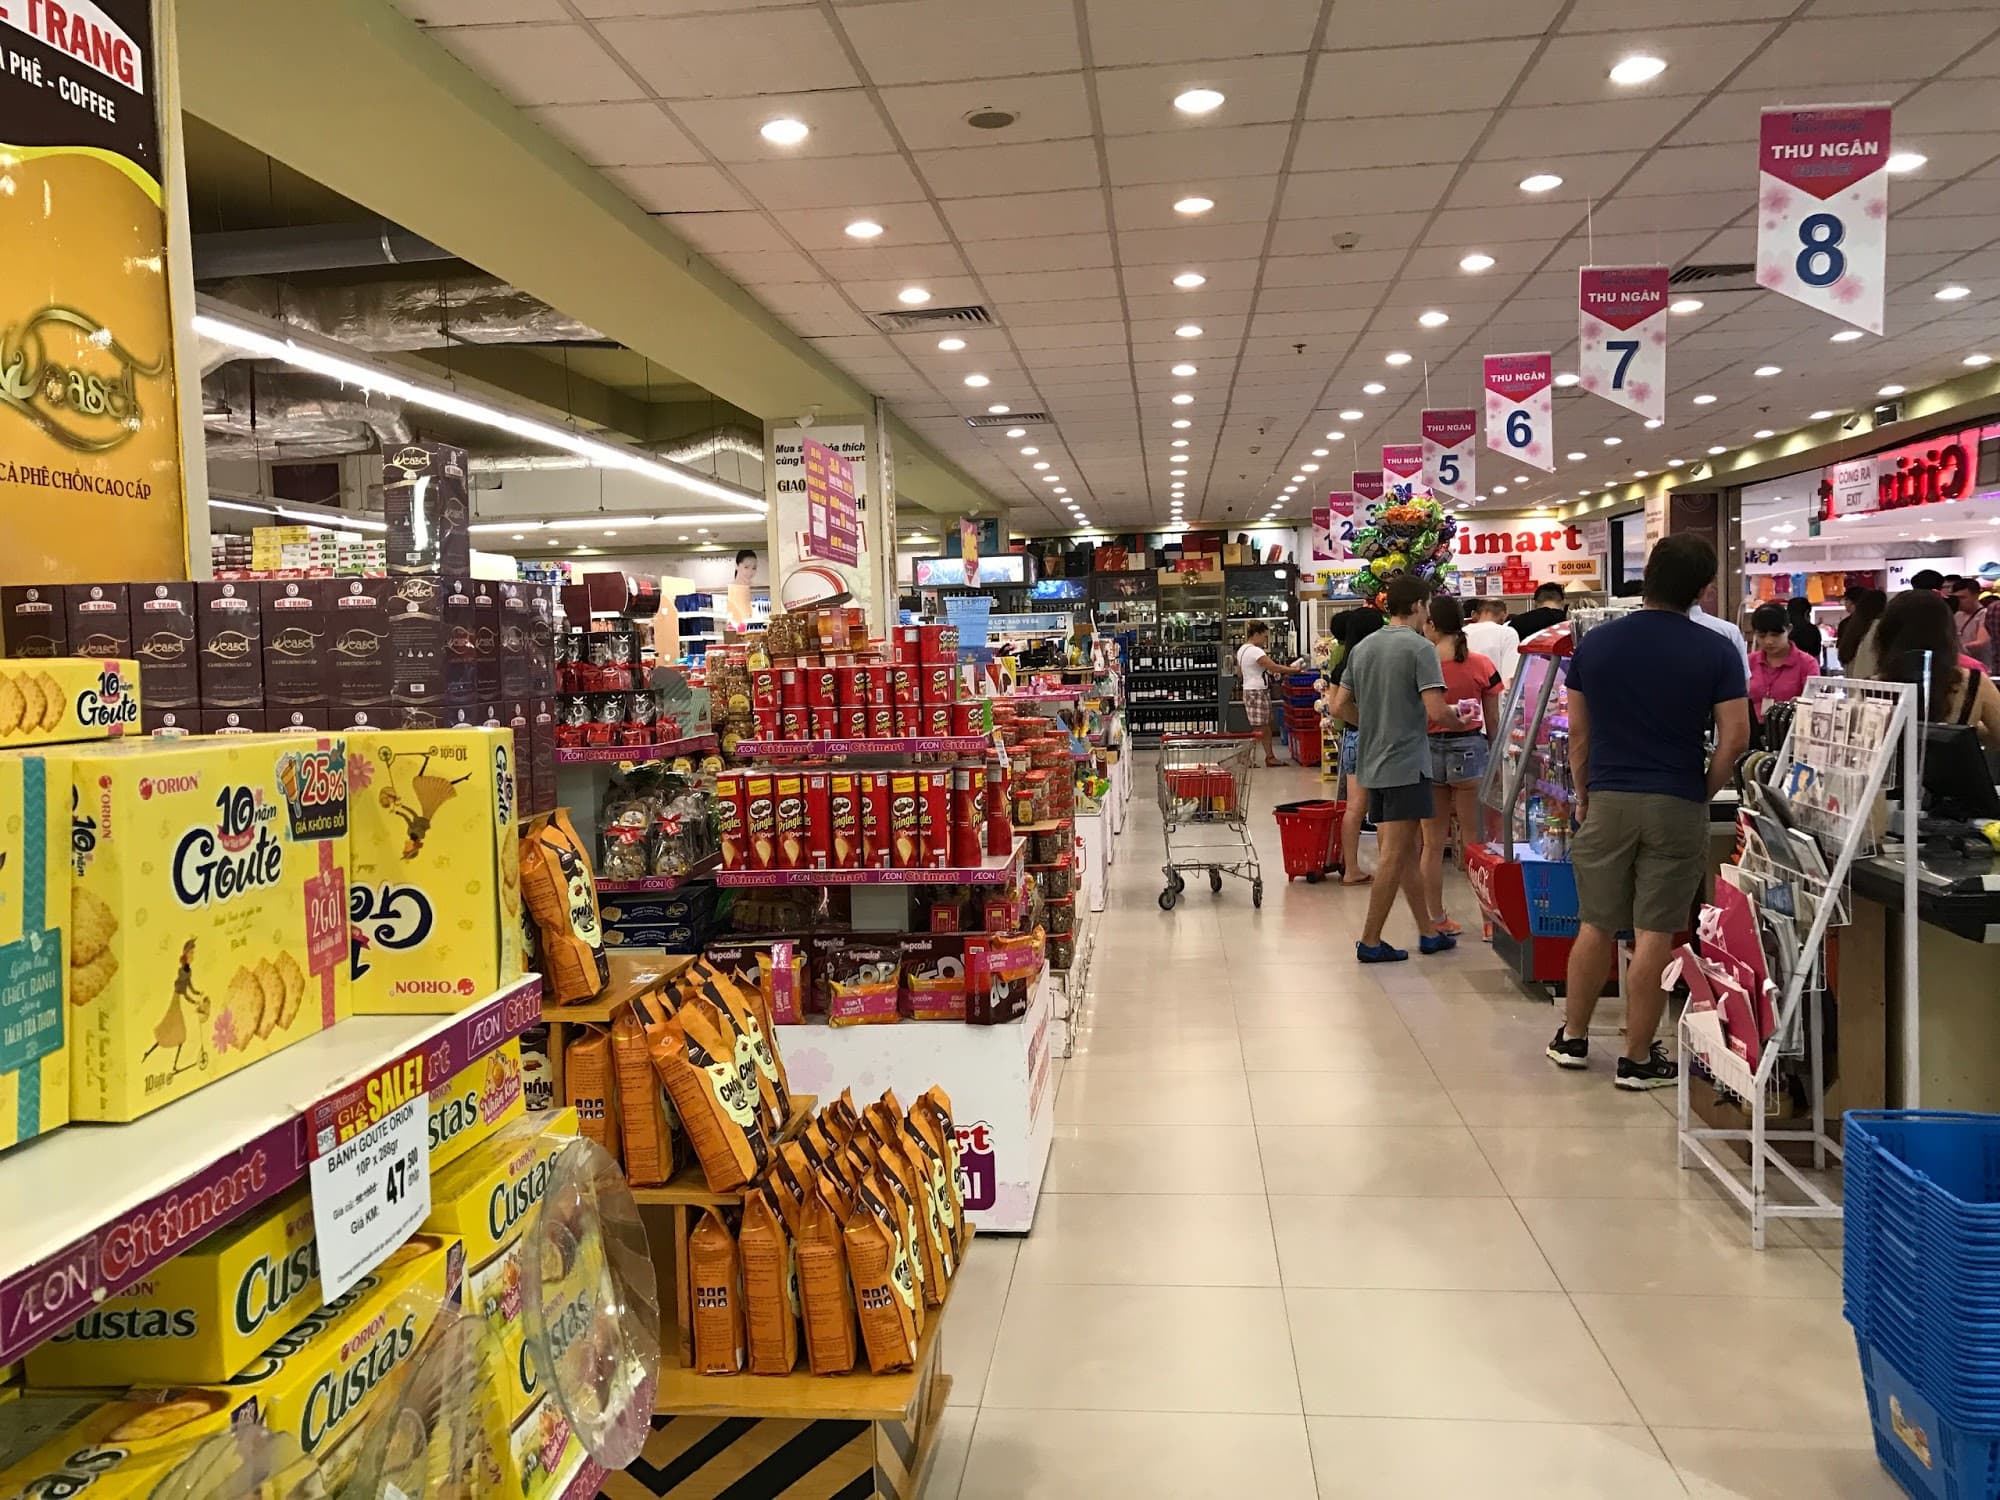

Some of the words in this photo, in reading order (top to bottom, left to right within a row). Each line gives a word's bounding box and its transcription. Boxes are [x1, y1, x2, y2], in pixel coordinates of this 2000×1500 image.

[27, 0, 135, 86] TRANG
[58, 75, 117, 123] COFFEE
[1771, 143, 1813, 159] THU
[1819, 138, 1879, 157] NGÂN
[1796, 213, 1846, 288] 8
[1588, 292, 1616, 303] THU
[1490, 374, 1512, 382] THU
[1606, 340, 1640, 390] 7
[1426, 424, 1445, 432] THU
[1506, 410, 1532, 448] 6
[21, 464, 49, 488] PHÊ
[95, 476, 125, 498] CAO
[1438, 454, 1460, 485] 5
[1846, 491, 1864, 506] EXIT
[77, 690, 137, 726] Gouté
[157, 776, 198, 796] ORION
[302, 758, 345, 806] 25%
[101, 794, 112, 839] ORION
[217, 786, 255, 837] 10
[173, 826, 281, 905] Gouté
[395, 979, 451, 994] ORION
[366, 1055, 424, 1122] SALE!
[328, 1143, 358, 1173] BÁNH
[360, 1121, 388, 1153] GOUTE
[389, 1103, 414, 1131] ORION
[429, 1091, 478, 1151] stas
[101, 1149, 266, 1282] Citimart
[301, 1311, 418, 1454] Custas
